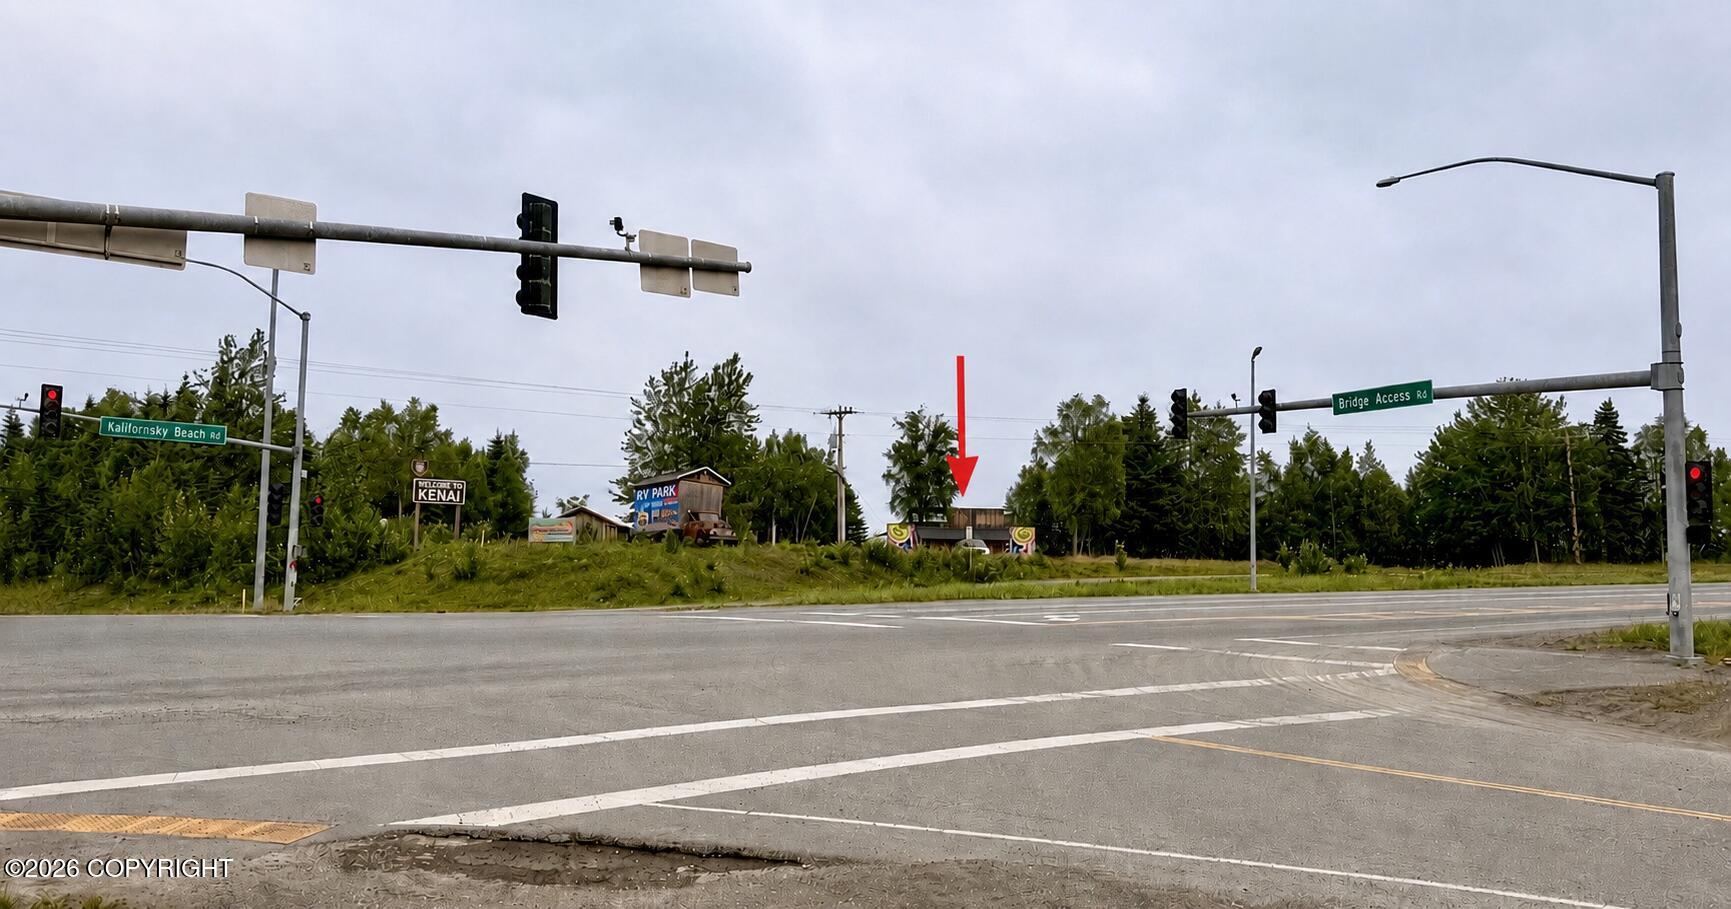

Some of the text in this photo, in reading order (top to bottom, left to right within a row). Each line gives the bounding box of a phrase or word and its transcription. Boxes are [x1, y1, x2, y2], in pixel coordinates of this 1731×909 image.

[1339, 389, 1428, 409] Bridge Access Rd
[108, 421, 221, 440] Kalifornsky Beach Rd
[453, 482, 463, 490] TO
[636, 484, 676, 501] RV PARK
[418, 488, 461, 502] KENAI
